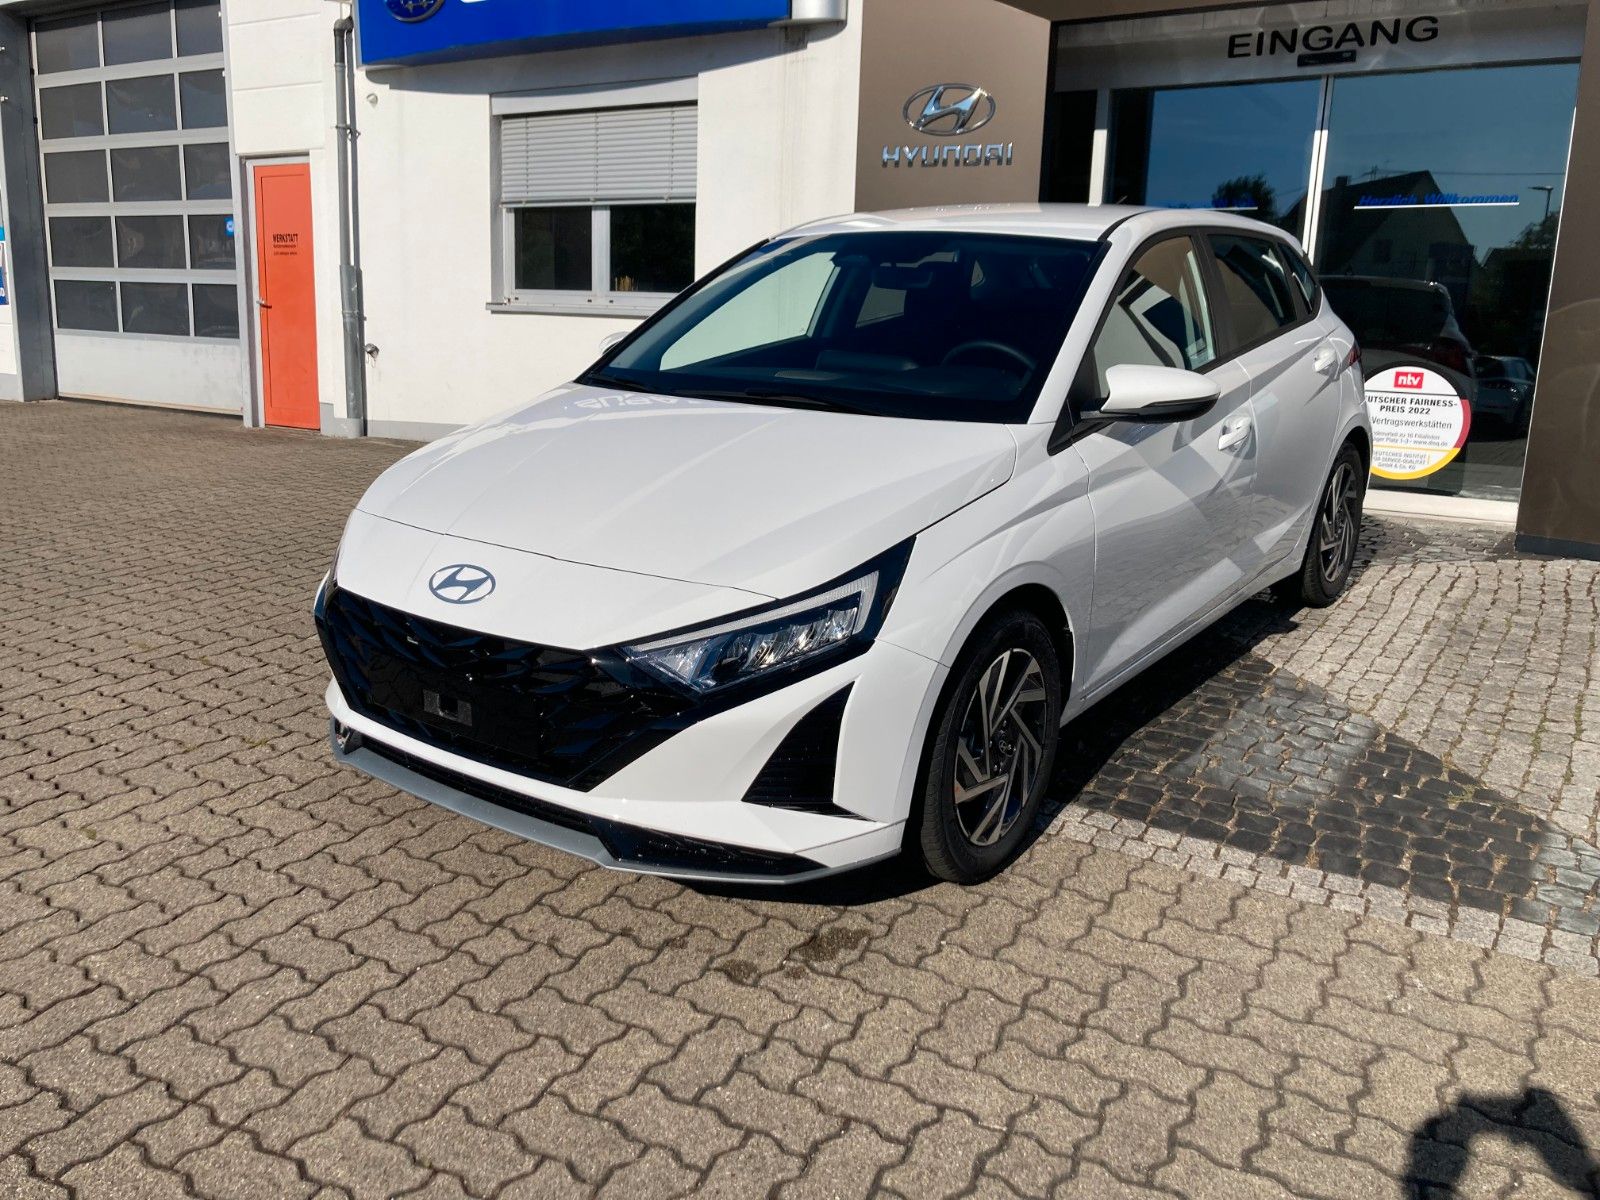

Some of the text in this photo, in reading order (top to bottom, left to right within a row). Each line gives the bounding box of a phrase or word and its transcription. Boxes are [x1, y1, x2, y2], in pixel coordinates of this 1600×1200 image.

[1227, 15, 1439, 59] EINGANG
[881, 142, 1013, 168] HYUNDAI
[272, 233, 298, 243] WERKSTATT
[1398, 373, 1421, 386] ntv
[1366, 395, 1458, 408] UTSCHER FAIRNESS-
[1379, 405, 1431, 415] PREIS 2022
